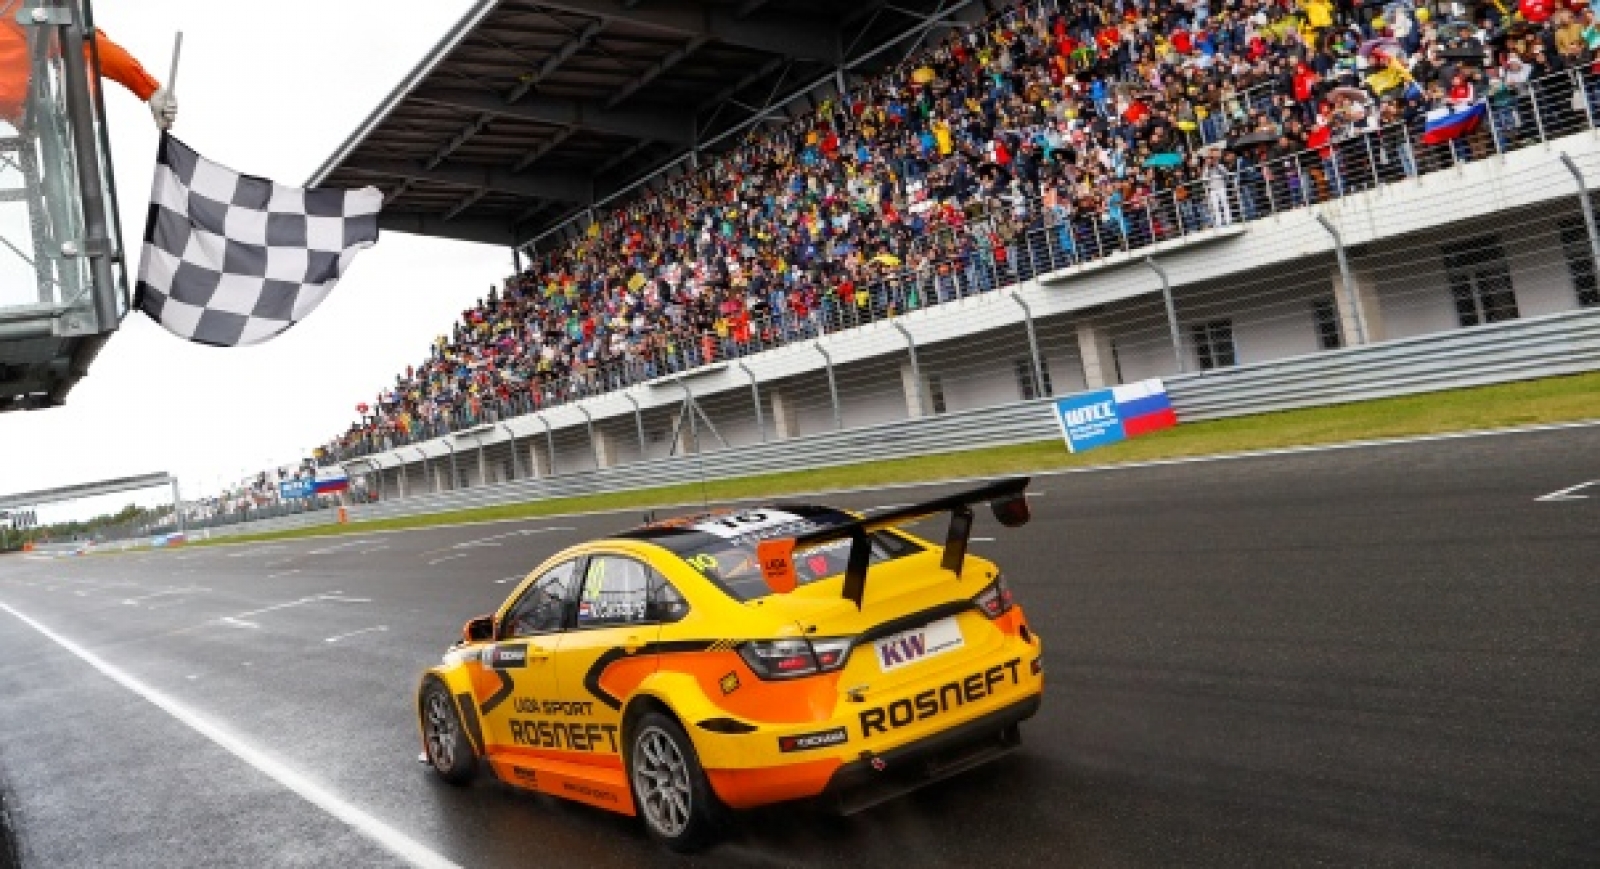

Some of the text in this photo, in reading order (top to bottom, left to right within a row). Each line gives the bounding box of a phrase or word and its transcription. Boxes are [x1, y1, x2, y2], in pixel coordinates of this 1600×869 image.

[881, 633, 925, 667] KW
[542, 701, 593, 715] SPORT
[858, 657, 1021, 738] ROSNEFT
[509, 719, 618, 753] ROSNEFT
